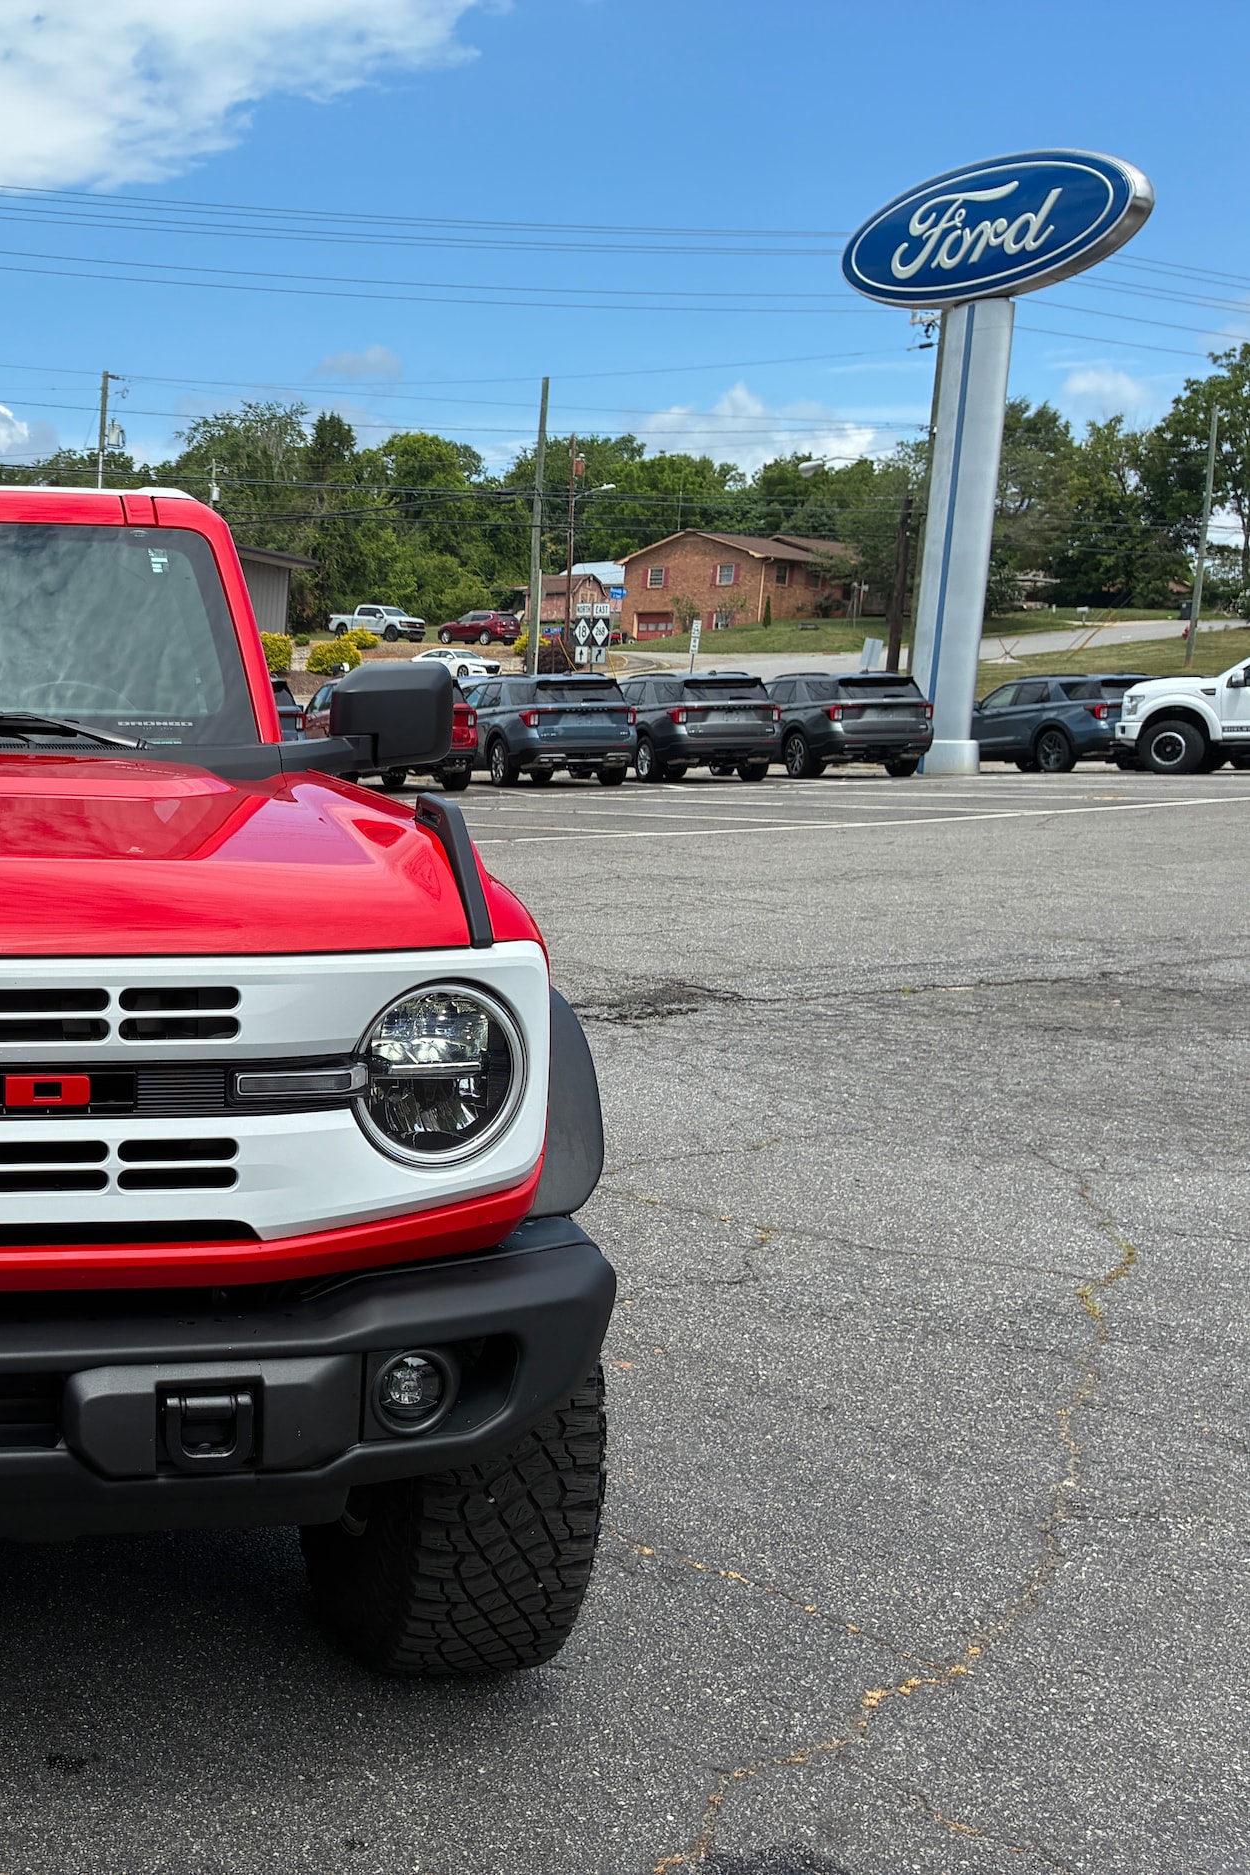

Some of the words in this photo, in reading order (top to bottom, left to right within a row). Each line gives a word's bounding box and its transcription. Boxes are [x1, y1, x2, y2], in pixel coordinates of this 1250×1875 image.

[891, 180, 1063, 279] Ford
[577, 605, 590, 613] NORTH
[595, 605, 608, 614] EAST
[578, 625, 587, 638] 18
[595, 627, 605, 636] 268
